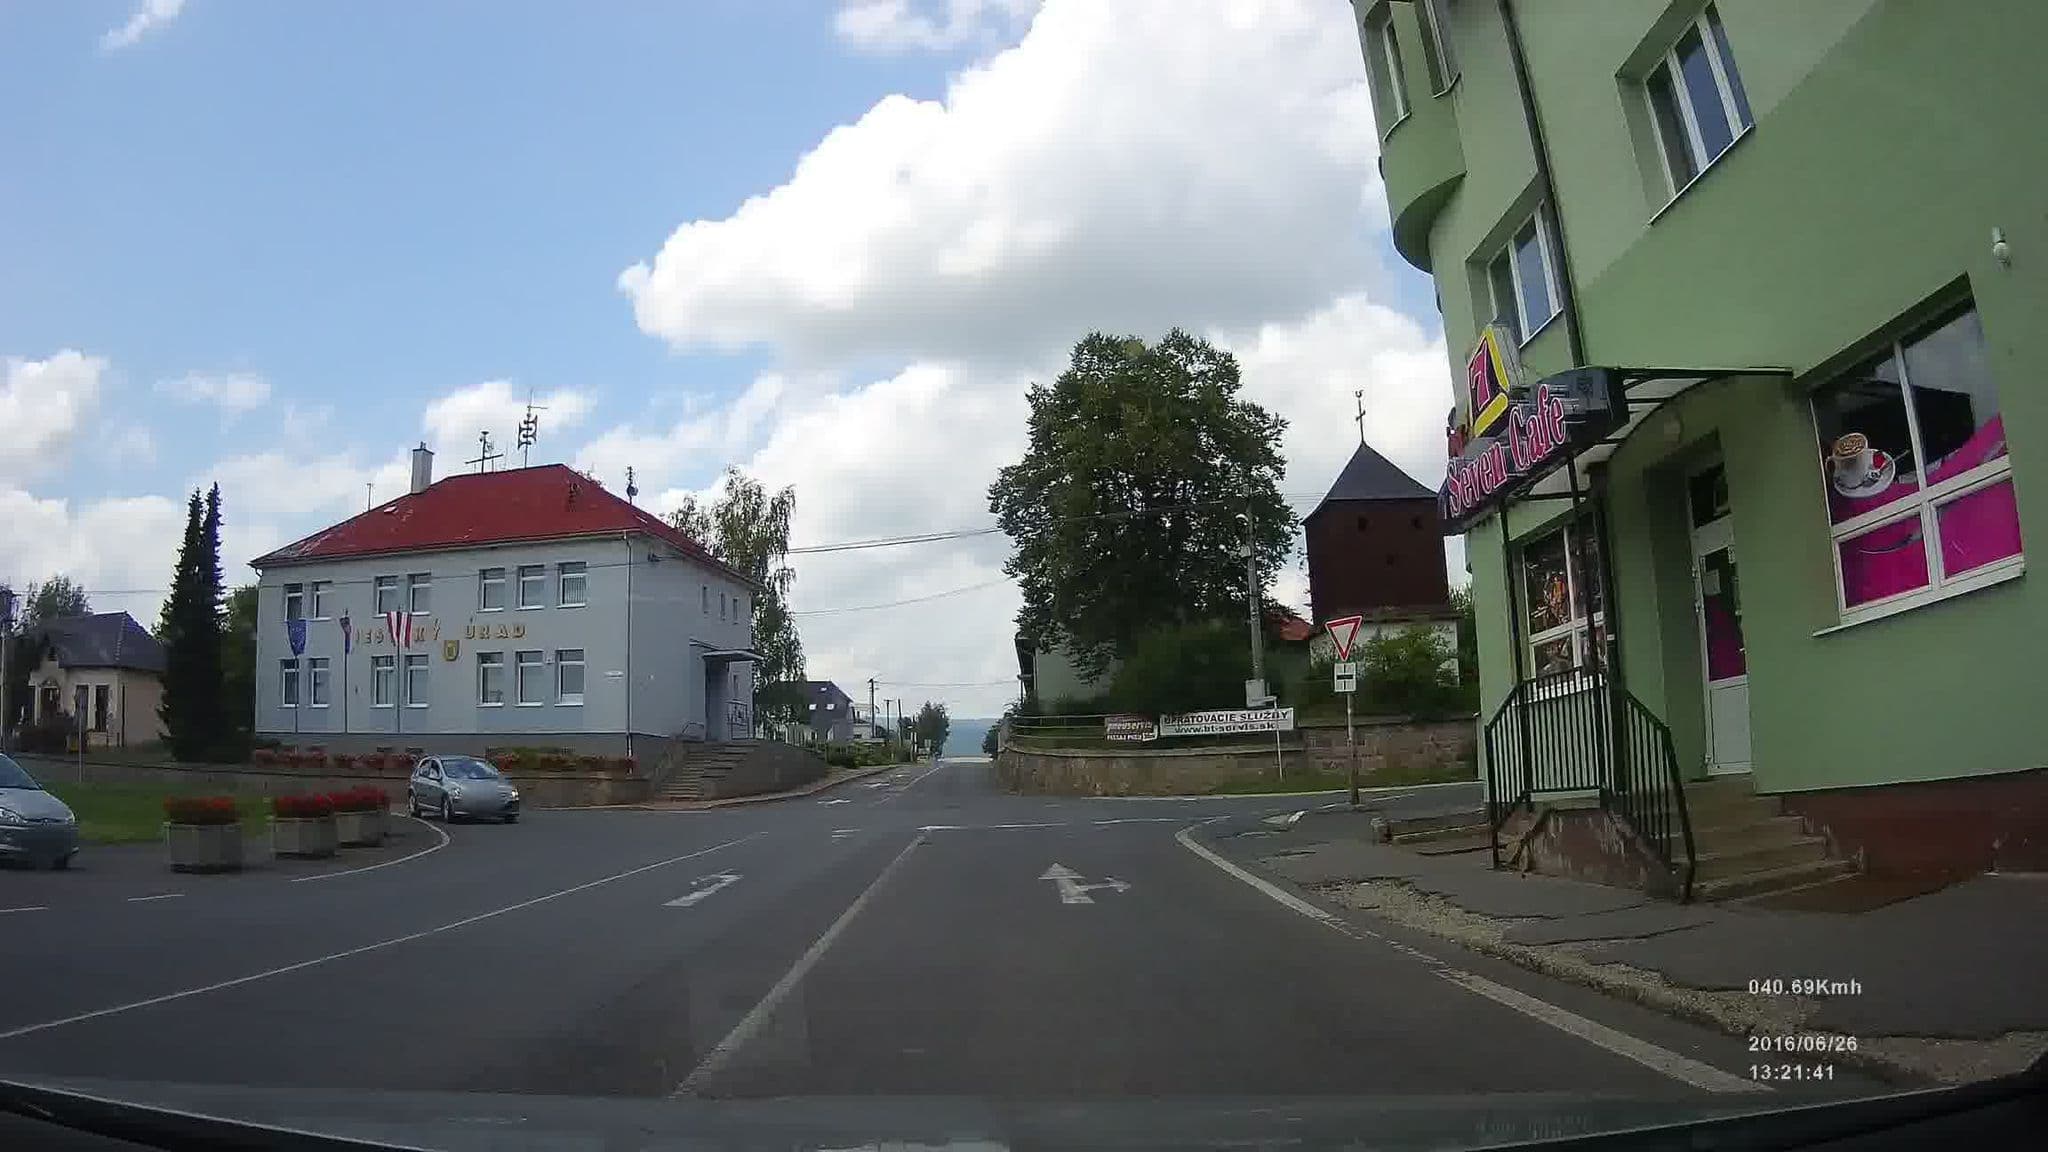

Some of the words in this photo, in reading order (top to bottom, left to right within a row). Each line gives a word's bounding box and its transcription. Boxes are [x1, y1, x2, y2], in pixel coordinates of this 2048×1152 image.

[1447, 441, 1508, 517] Seven
[1508, 384, 1566, 471] Cafe
[465, 616, 527, 640] ÚRAD
